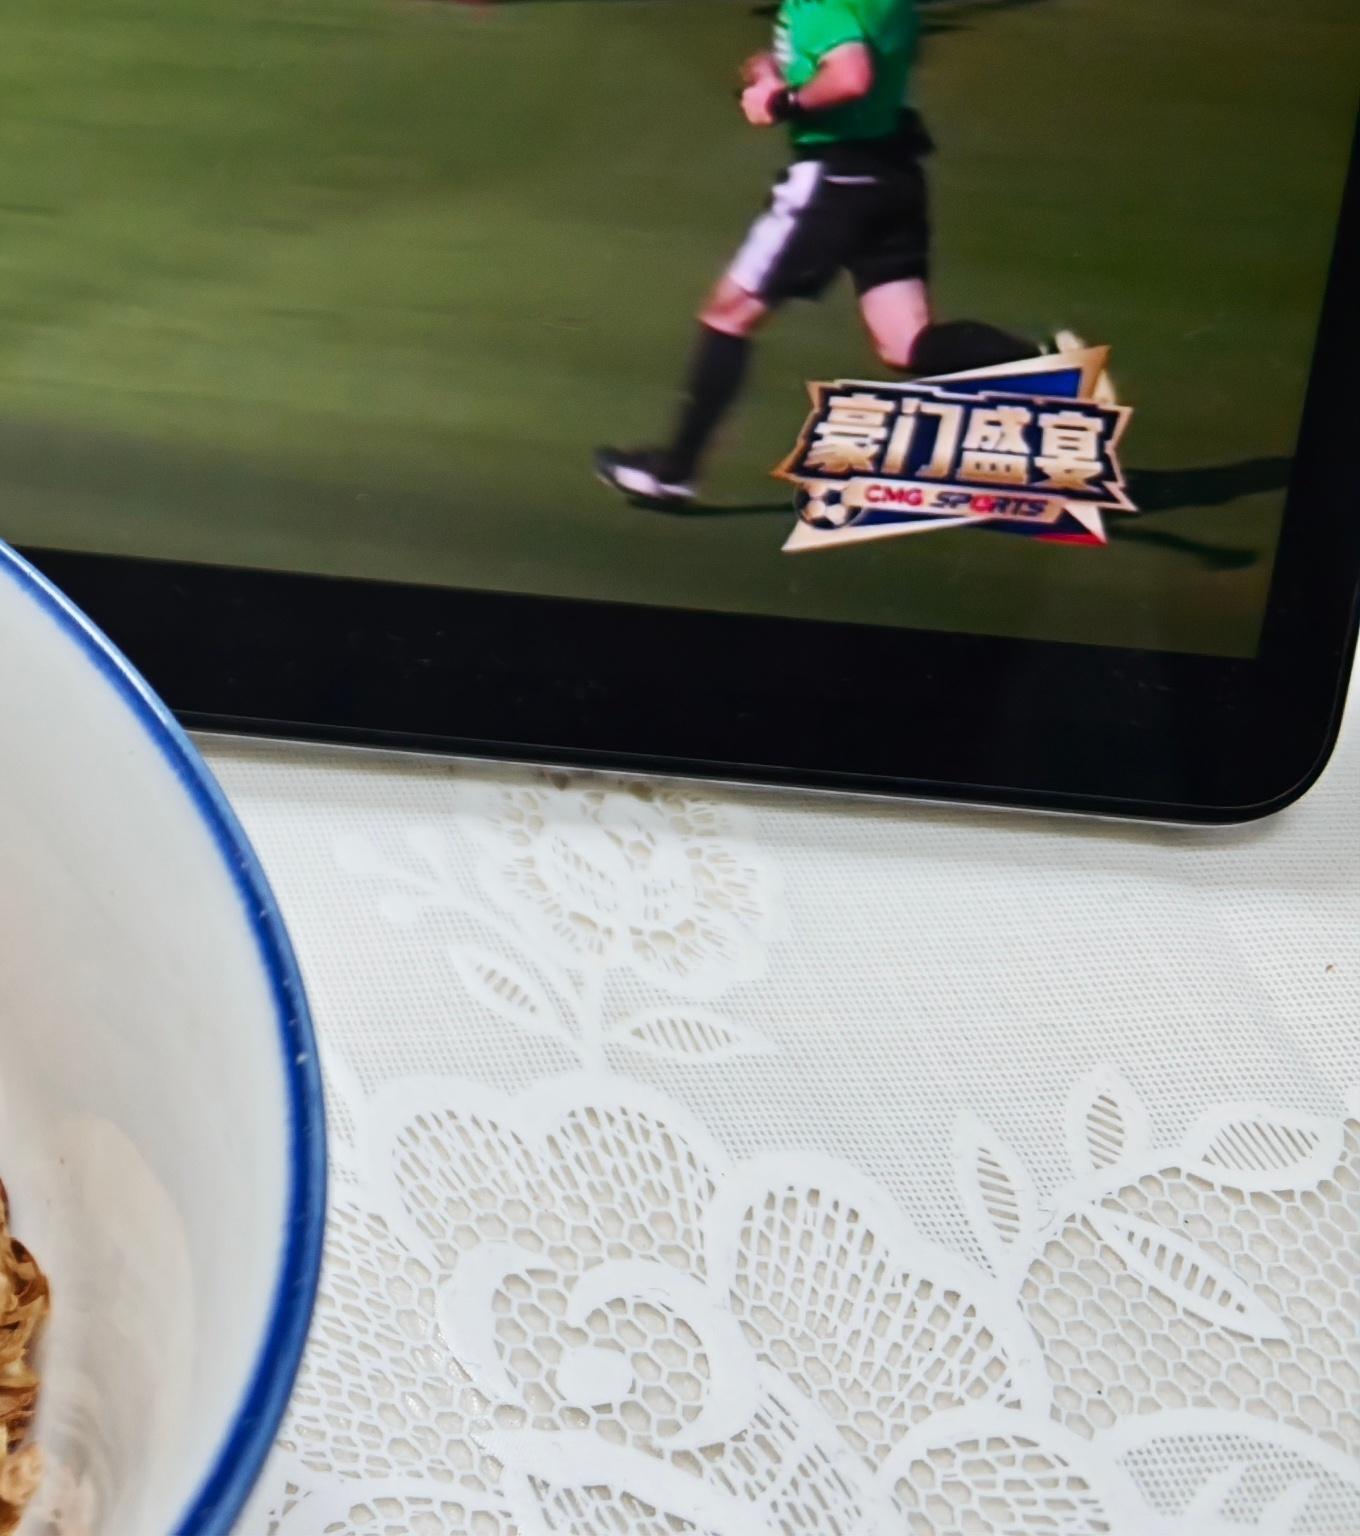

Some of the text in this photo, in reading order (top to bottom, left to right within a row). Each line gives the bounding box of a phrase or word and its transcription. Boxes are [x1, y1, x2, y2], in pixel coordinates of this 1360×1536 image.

[804, 394, 1104, 492] 豪门盛宴
[864, 484, 1048, 517] CMG SPORTS
